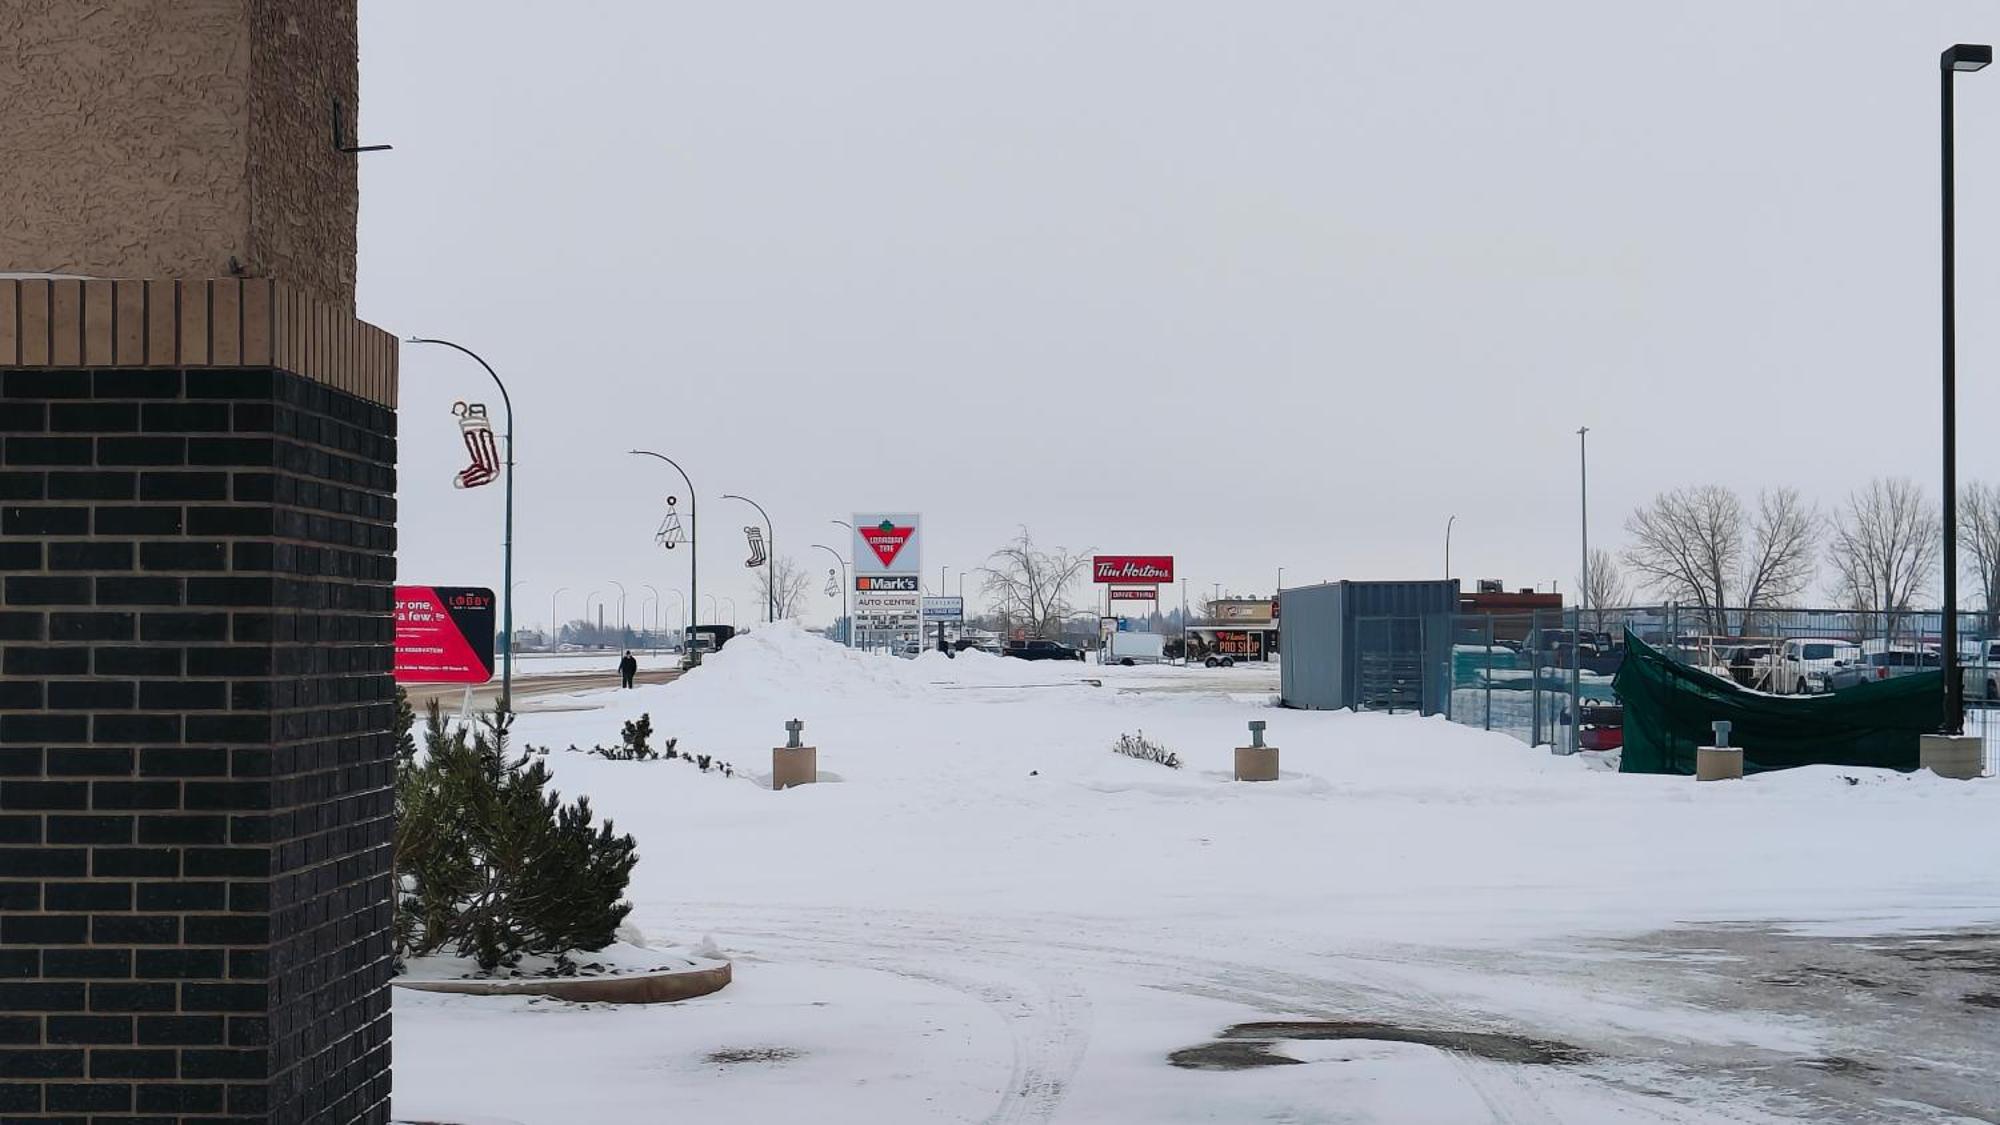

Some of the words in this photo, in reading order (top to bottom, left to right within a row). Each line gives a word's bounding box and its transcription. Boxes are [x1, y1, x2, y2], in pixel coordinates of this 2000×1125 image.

[1097, 563, 1120, 577] Tim
[1121, 562, 1169, 577] Hortons
[871, 578, 915, 589] Mark's
[449, 596, 489, 606] LOBBY
[1219, 641, 1236, 653] PRO
